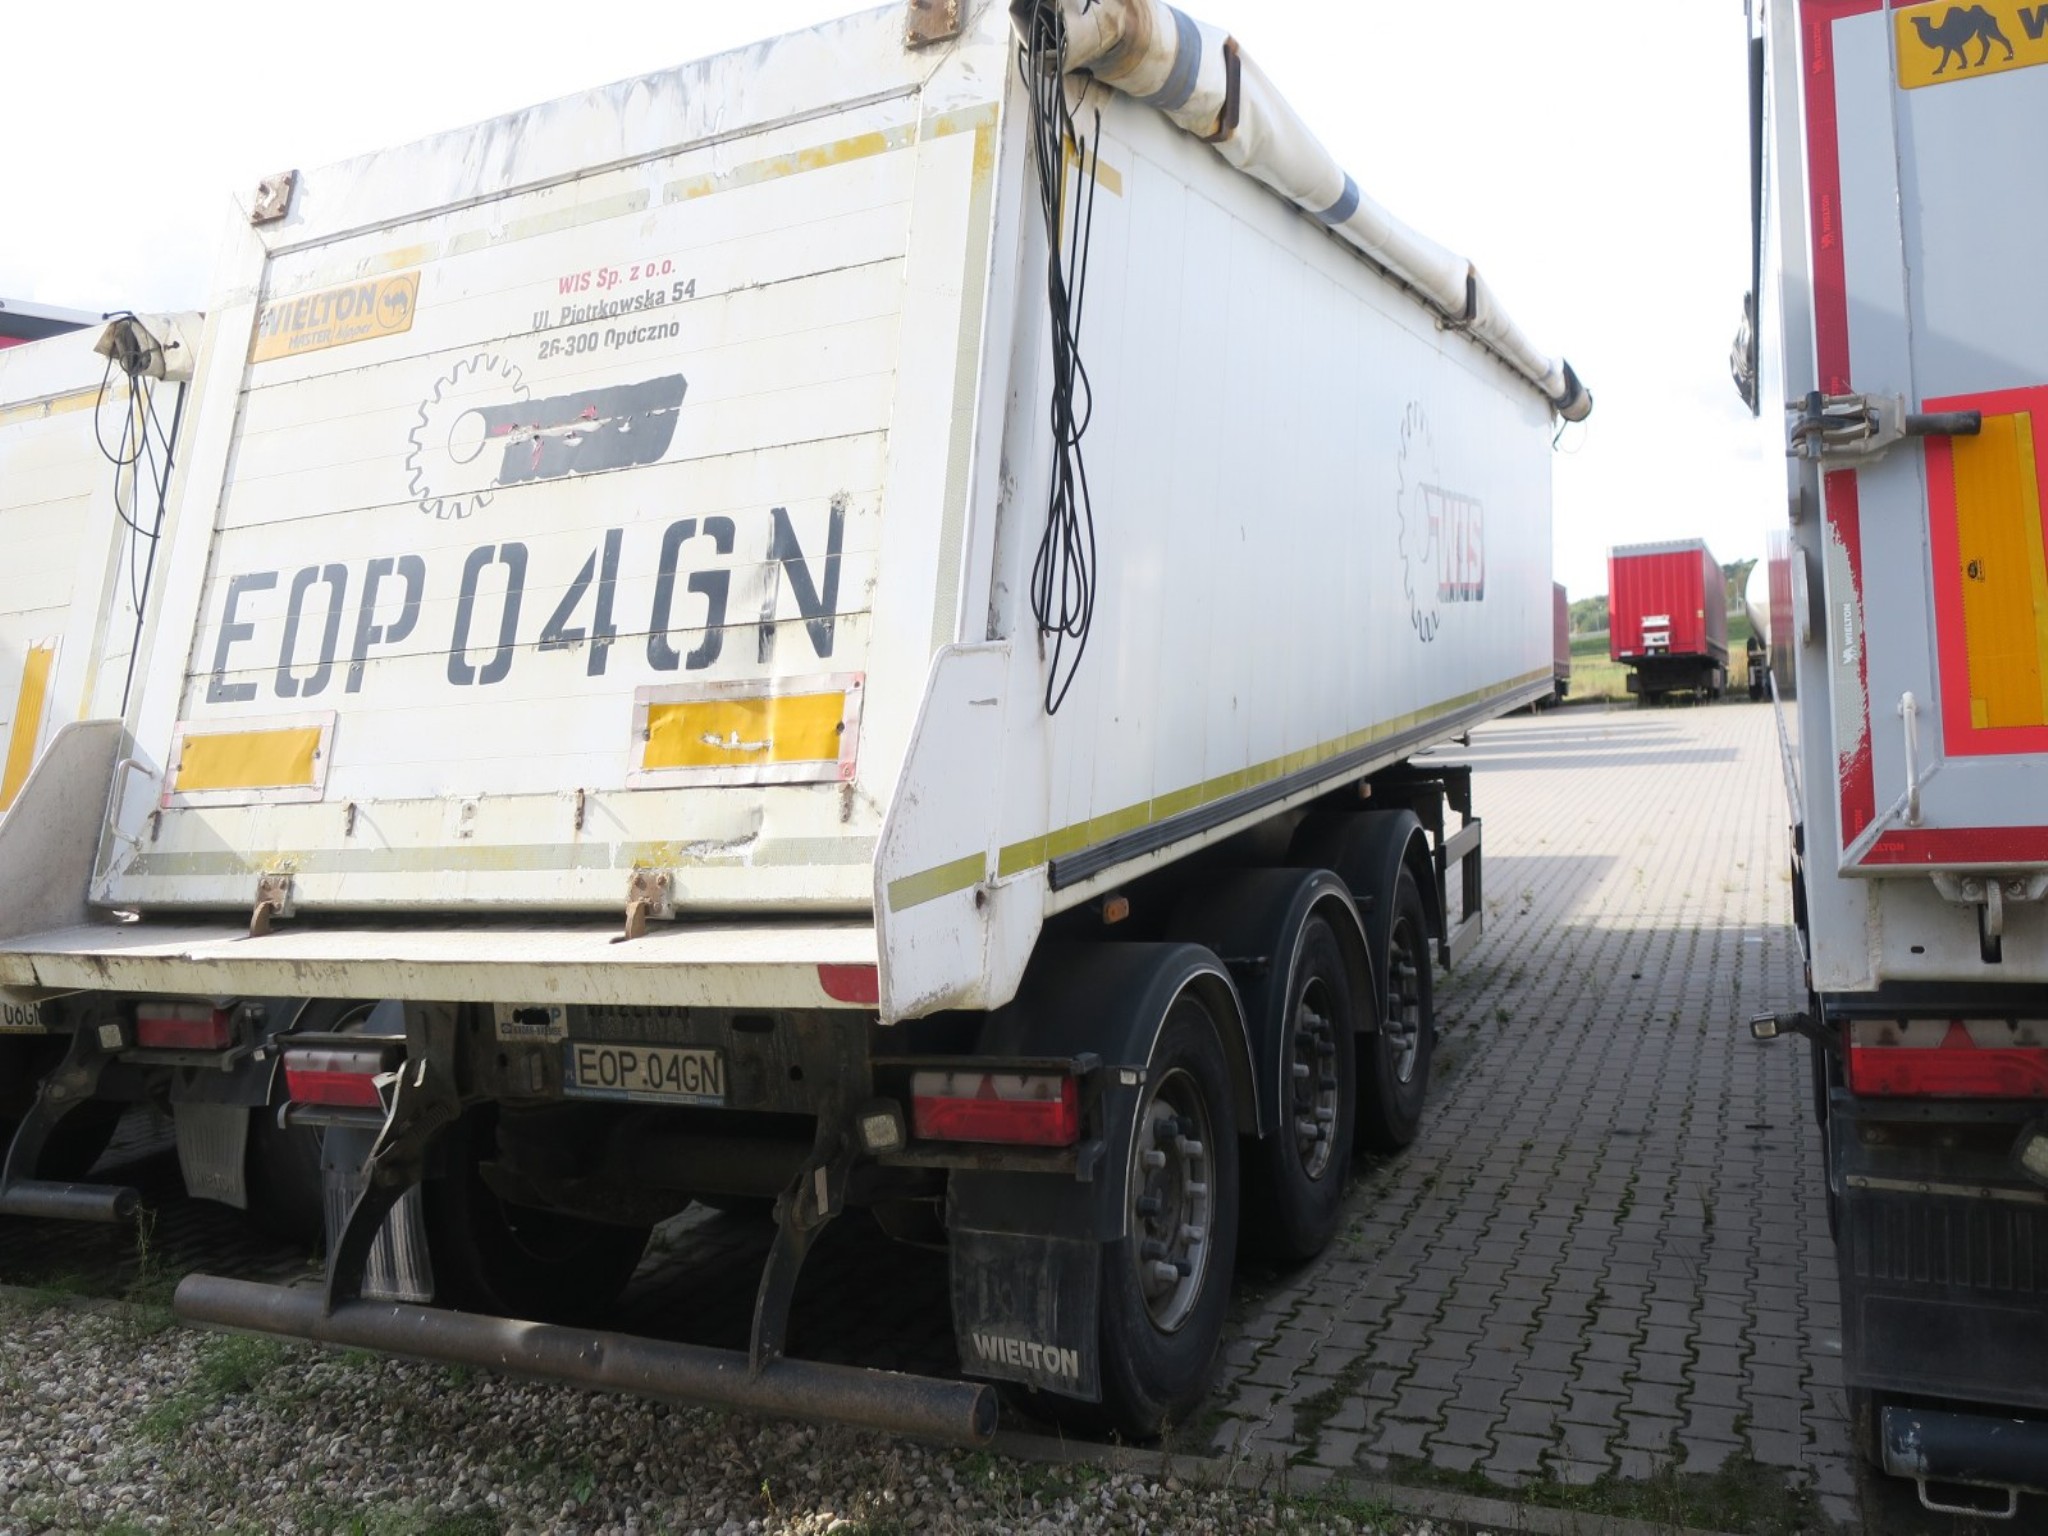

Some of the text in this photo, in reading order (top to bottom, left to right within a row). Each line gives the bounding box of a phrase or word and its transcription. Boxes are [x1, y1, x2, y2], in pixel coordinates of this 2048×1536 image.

[558, 259, 676, 295] WIS Sp. z o.o.
[559, 289, 666, 326] Piotrkowska
[672, 279, 696, 302] 54
[538, 331, 599, 360] 26-300
[1843, 603, 1853, 646] WIELTON
[972, 1332, 1079, 1378] WIELTON
